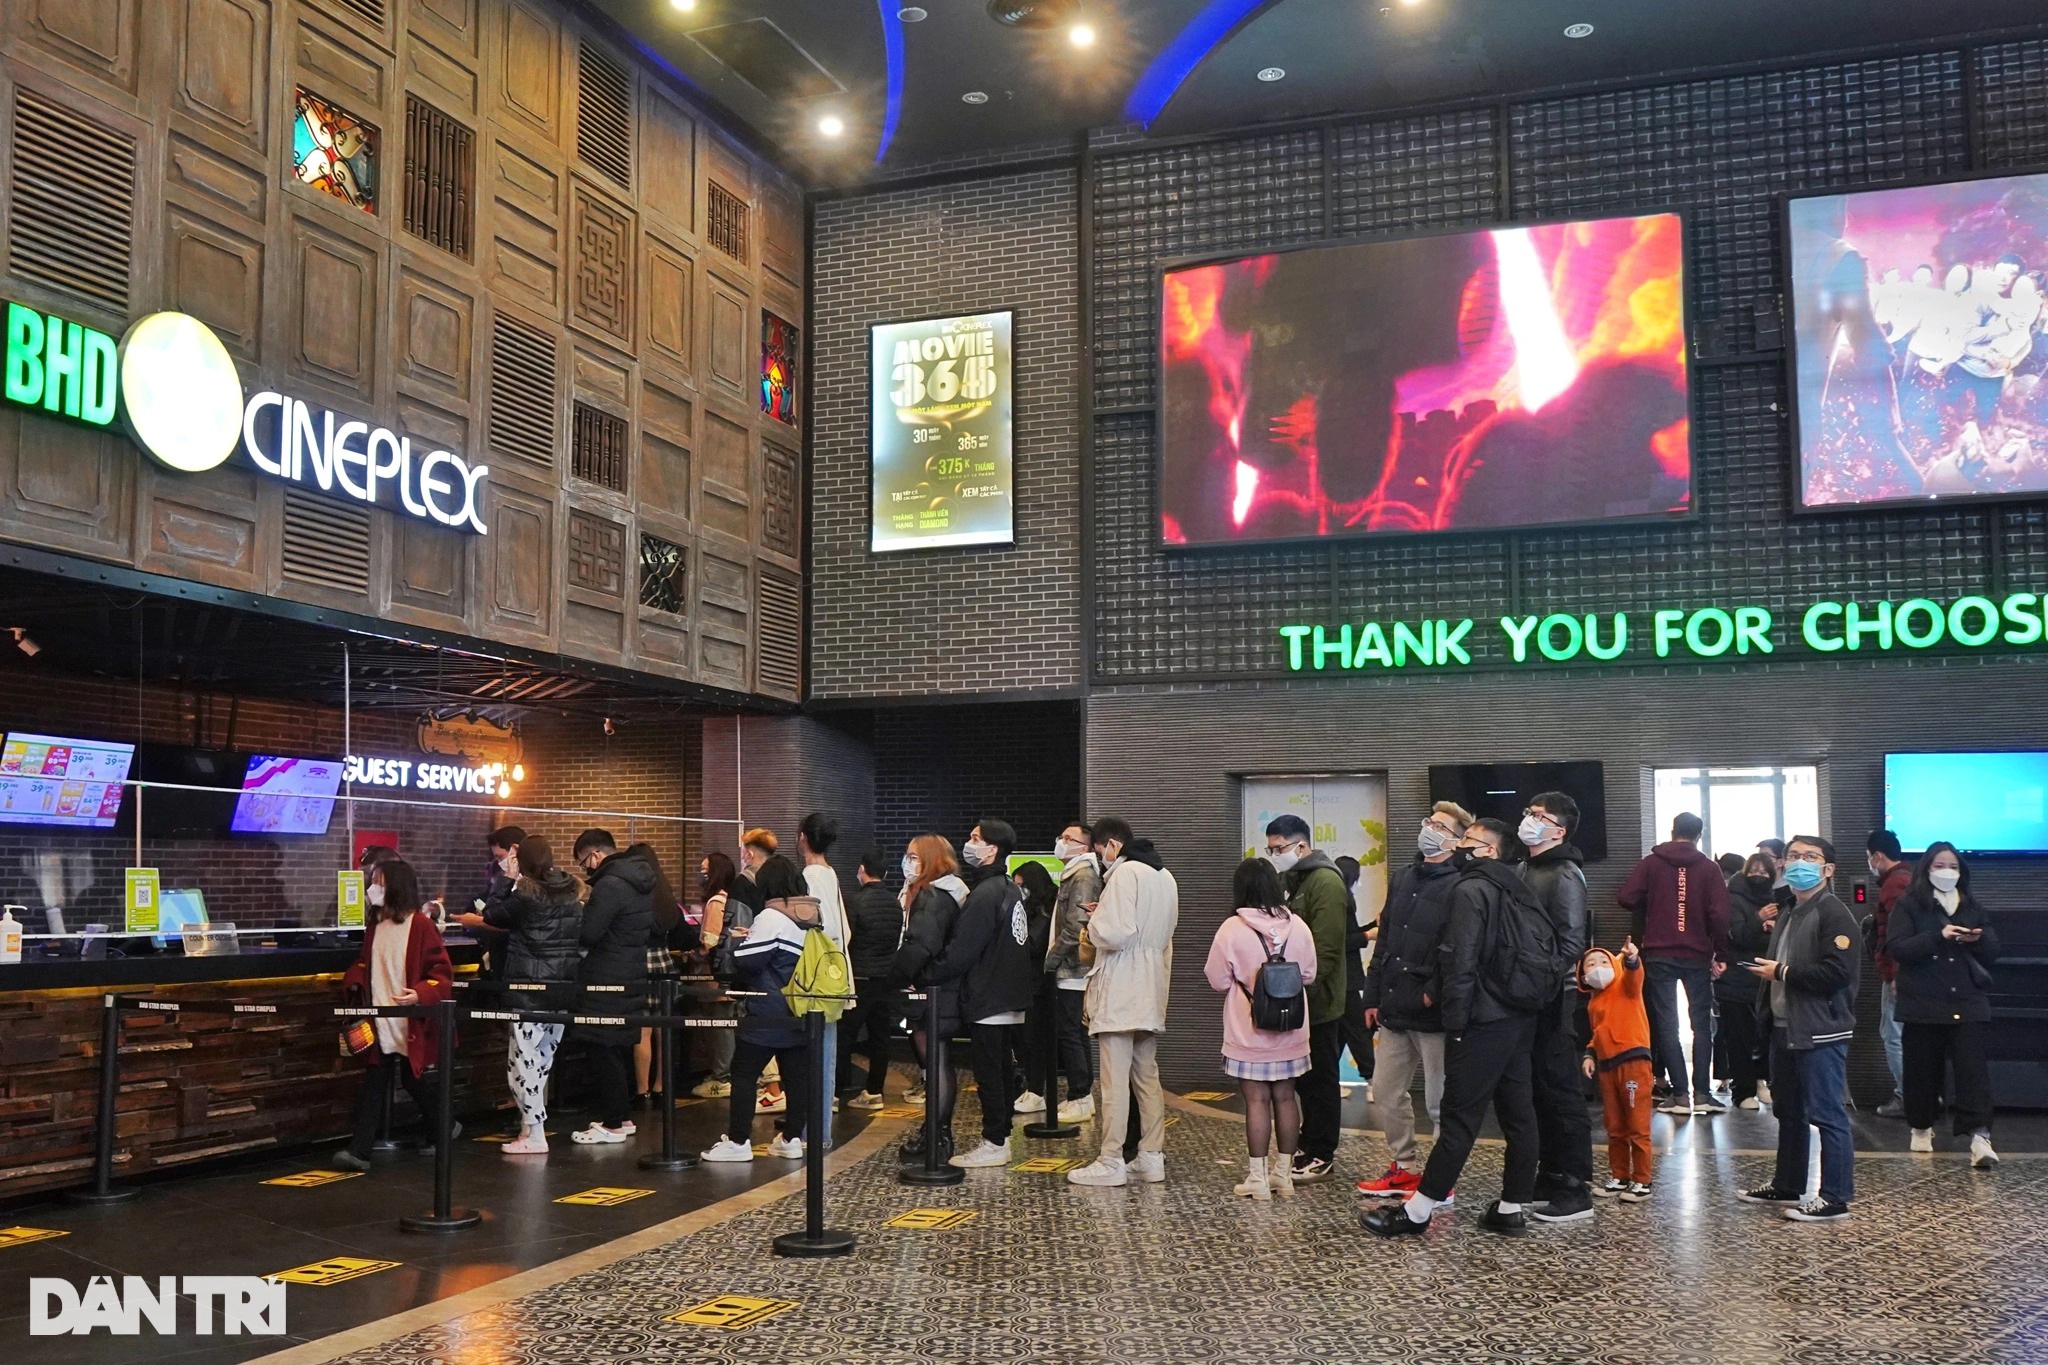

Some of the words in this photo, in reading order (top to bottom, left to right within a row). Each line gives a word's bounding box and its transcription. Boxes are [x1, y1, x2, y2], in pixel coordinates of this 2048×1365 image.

[893, 331, 994, 365] MOVIE
[889, 355, 997, 407] 365
[6, 302, 117, 425] BHD
[242, 392, 488, 535] CINEPLEX
[913, 429, 928, 443] 30
[958, 436, 978, 451] 365
[938, 458, 963, 475] 375
[962, 487, 979, 498] XEM
[1280, 619, 1473, 671] THANK
[1500, 612, 1627, 663] YOU
[1655, 606, 1773, 658] FOR
[72, 755, 85, 763] 39
[105, 757, 118, 766] 39
[342, 755, 412, 787] GUEST
[416, 763, 495, 795] SERVICE
[31, 785, 44, 793] 39
[1678, 867, 1687, 901] CHESTER
[1677, 902, 1686, 932] UNITED
